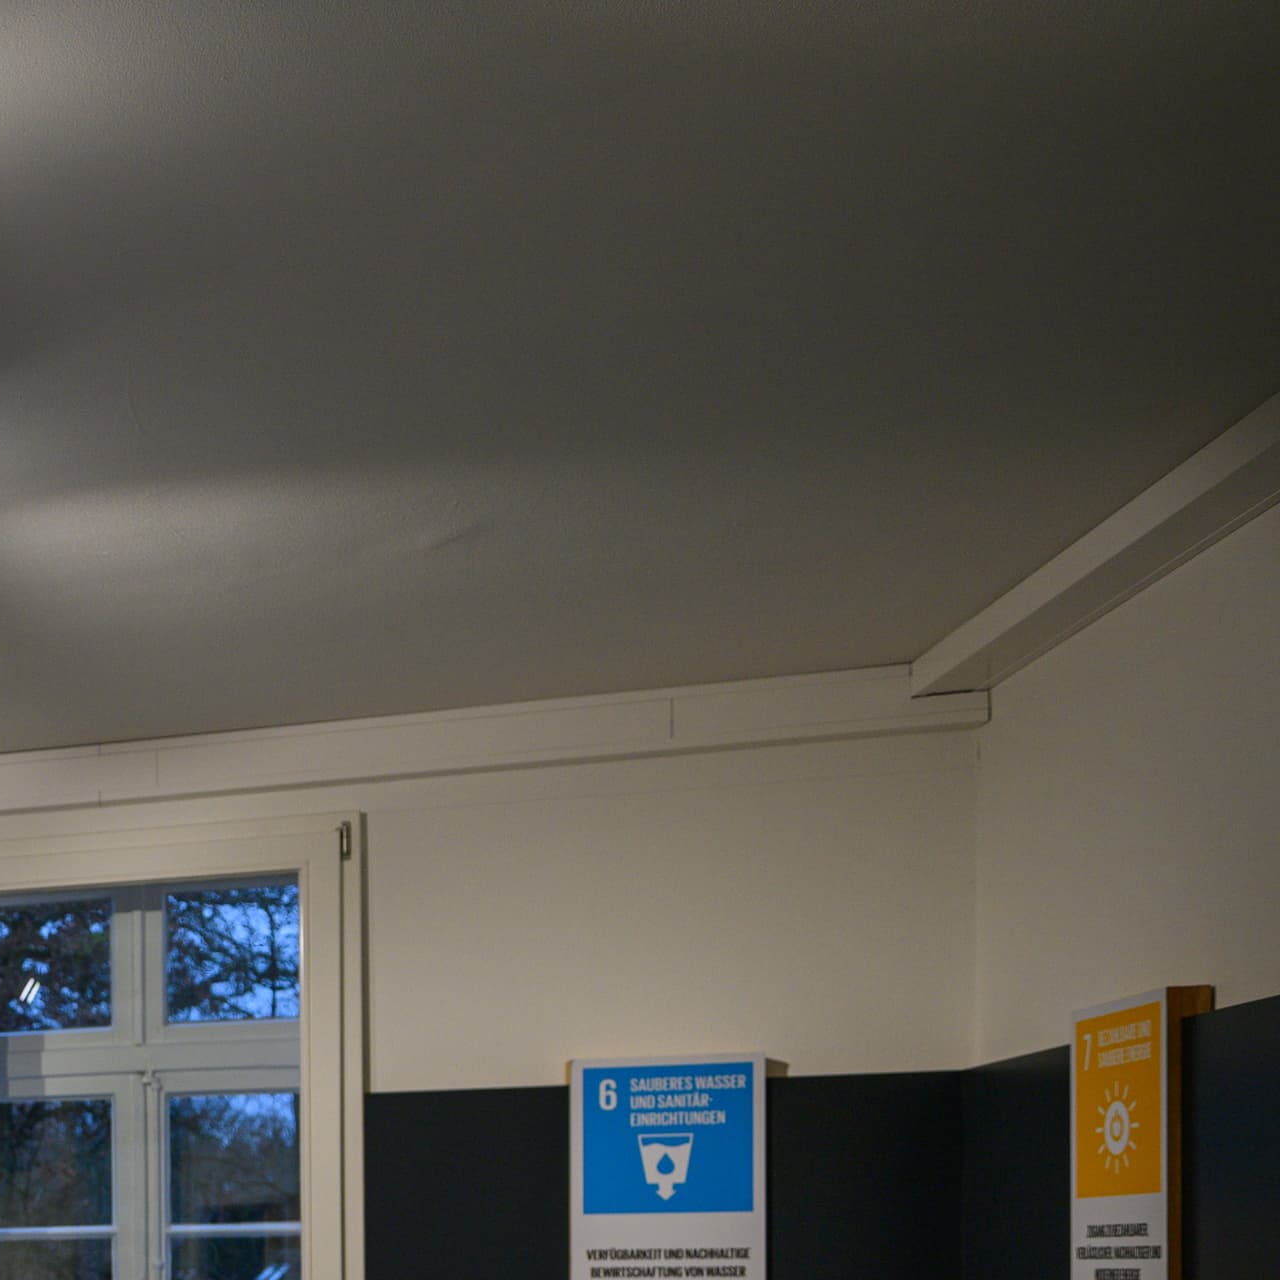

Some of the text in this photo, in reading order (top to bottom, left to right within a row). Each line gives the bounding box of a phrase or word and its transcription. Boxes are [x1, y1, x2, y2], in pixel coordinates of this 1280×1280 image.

[630, 1074, 747, 1092] SAUBERES WASSER
[599, 1079, 618, 1111] 6
[630, 1094, 655, 1109] UND
[630, 1110, 726, 1127] EINRICHTUNGEN
[663, 1248, 684, 1260] UND
[684, 1266, 705, 1278] VON
[706, 1265, 747, 1278] WASSER
